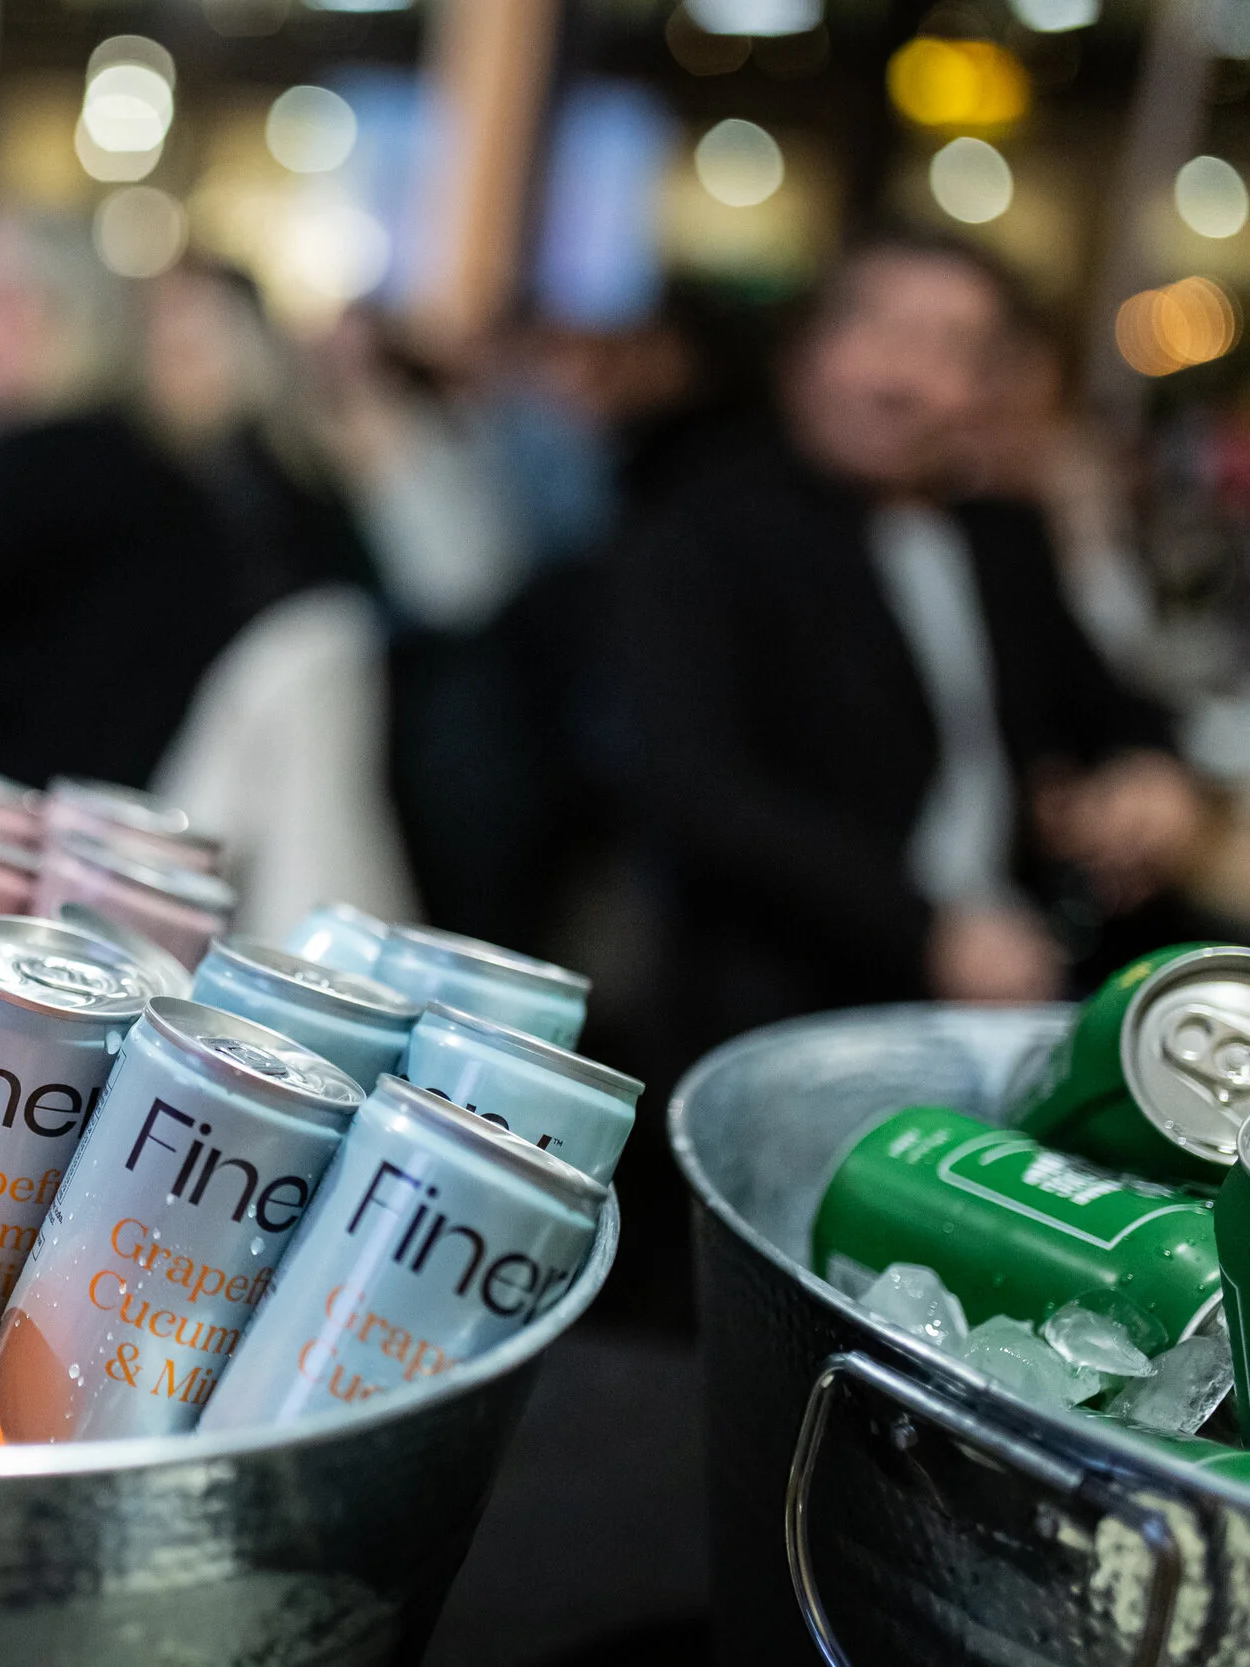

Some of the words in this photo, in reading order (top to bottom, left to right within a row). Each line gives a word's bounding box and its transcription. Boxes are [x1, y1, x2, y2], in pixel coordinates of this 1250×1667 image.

[88, 1270, 240, 1356] Cucum
[325, 1285, 454, 1382] Grap
[105, 1342, 143, 1389] &
